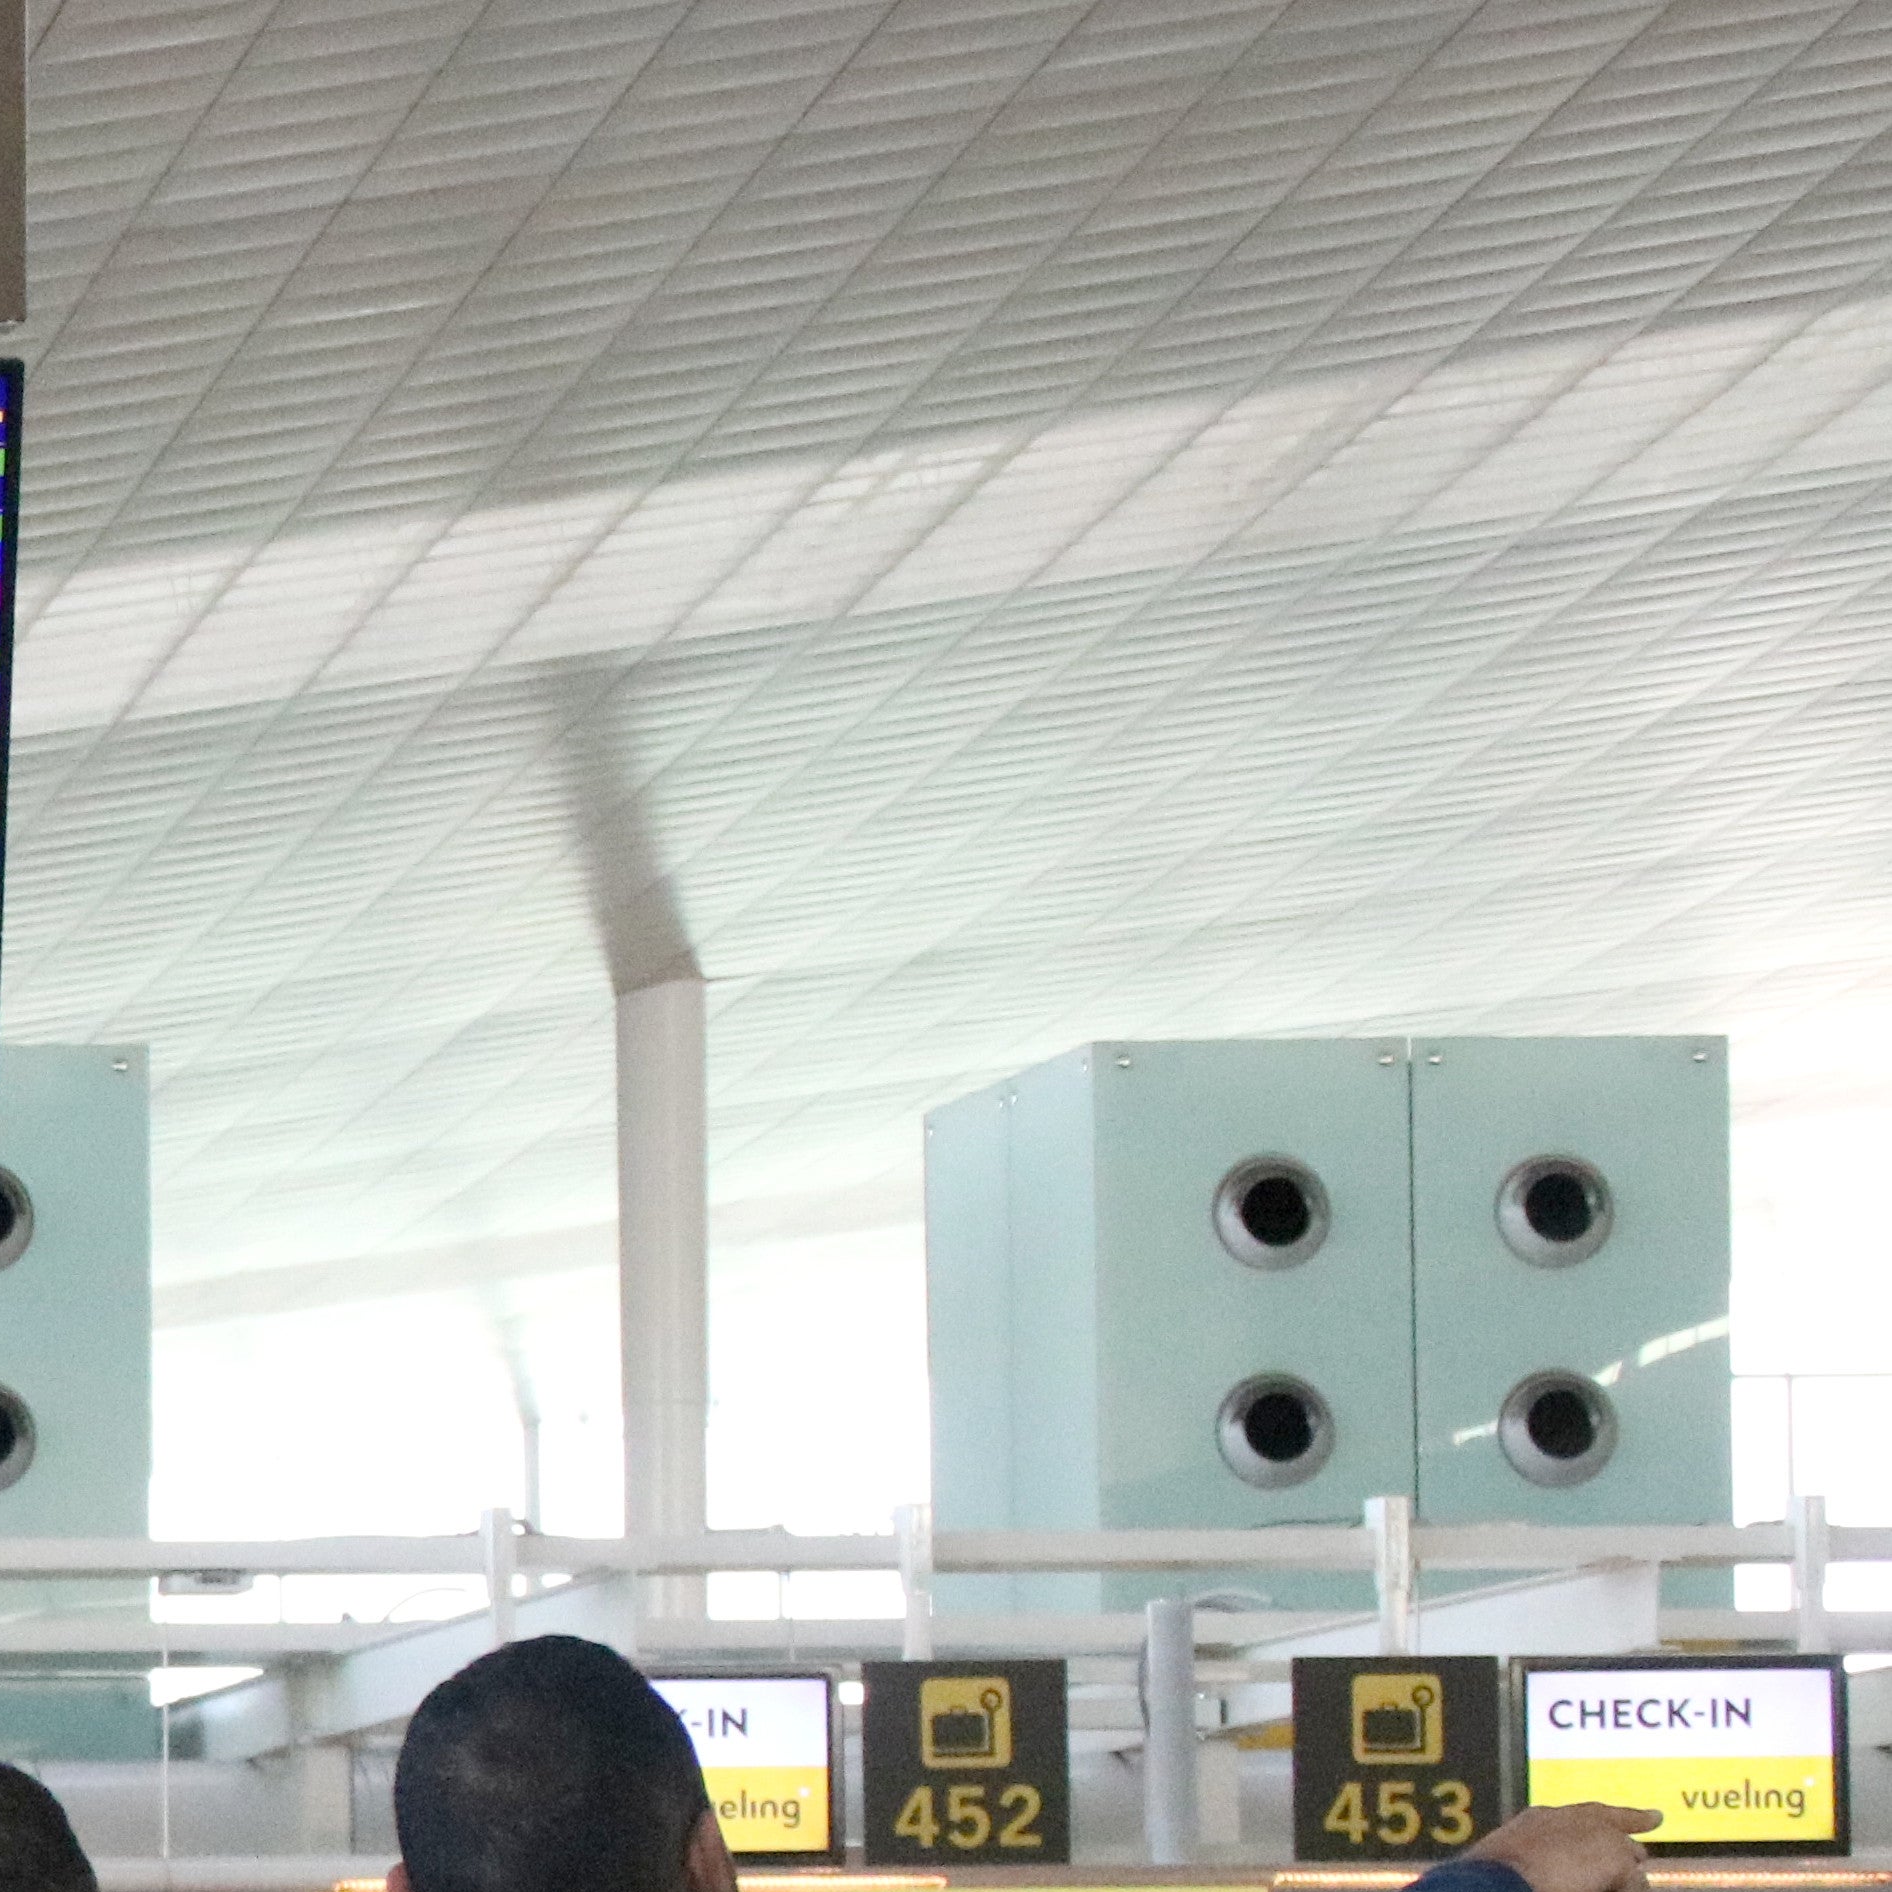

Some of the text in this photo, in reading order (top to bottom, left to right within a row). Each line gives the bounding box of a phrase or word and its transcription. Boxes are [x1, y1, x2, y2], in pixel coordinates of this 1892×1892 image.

[1548, 1698, 1751, 1729] CHECK-IN
[716, 1790, 800, 1828] eling
[895, 1784, 1041, 1848] 452
[1324, 1781, 1473, 1844] 453
[1682, 1779, 1805, 1819] vueling
